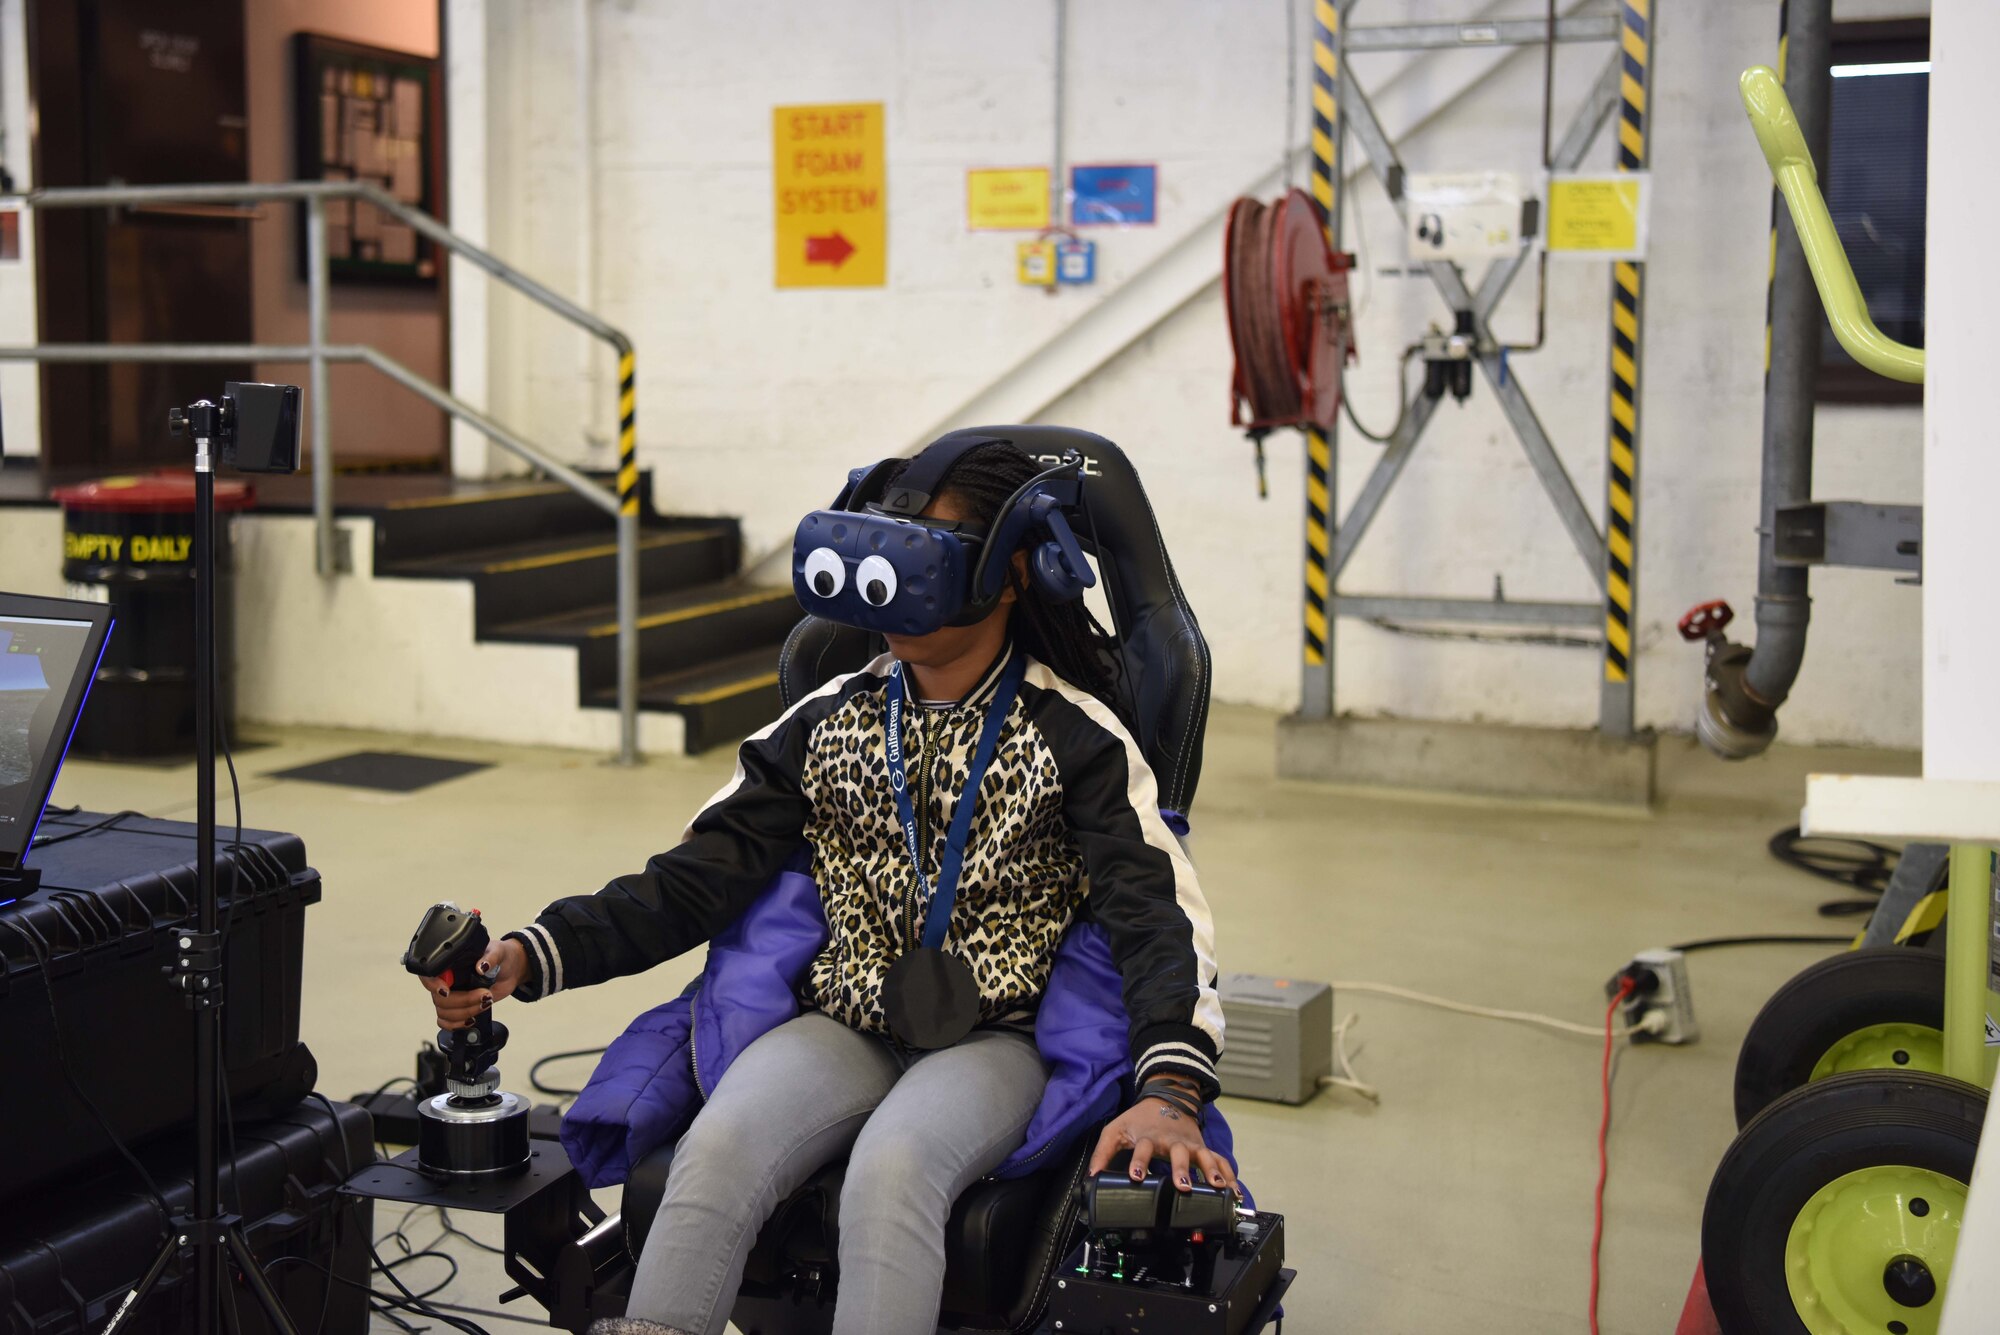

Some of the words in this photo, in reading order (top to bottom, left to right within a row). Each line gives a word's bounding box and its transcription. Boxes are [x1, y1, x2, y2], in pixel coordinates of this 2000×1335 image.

[790, 111, 866, 140] START
[793, 149, 864, 177] FOAM
[782, 185, 879, 214] SYSTEM
[65, 532, 123, 561] EMPTY
[131, 535, 192, 562] DAILY
[888, 699, 899, 762] Gulfstream
